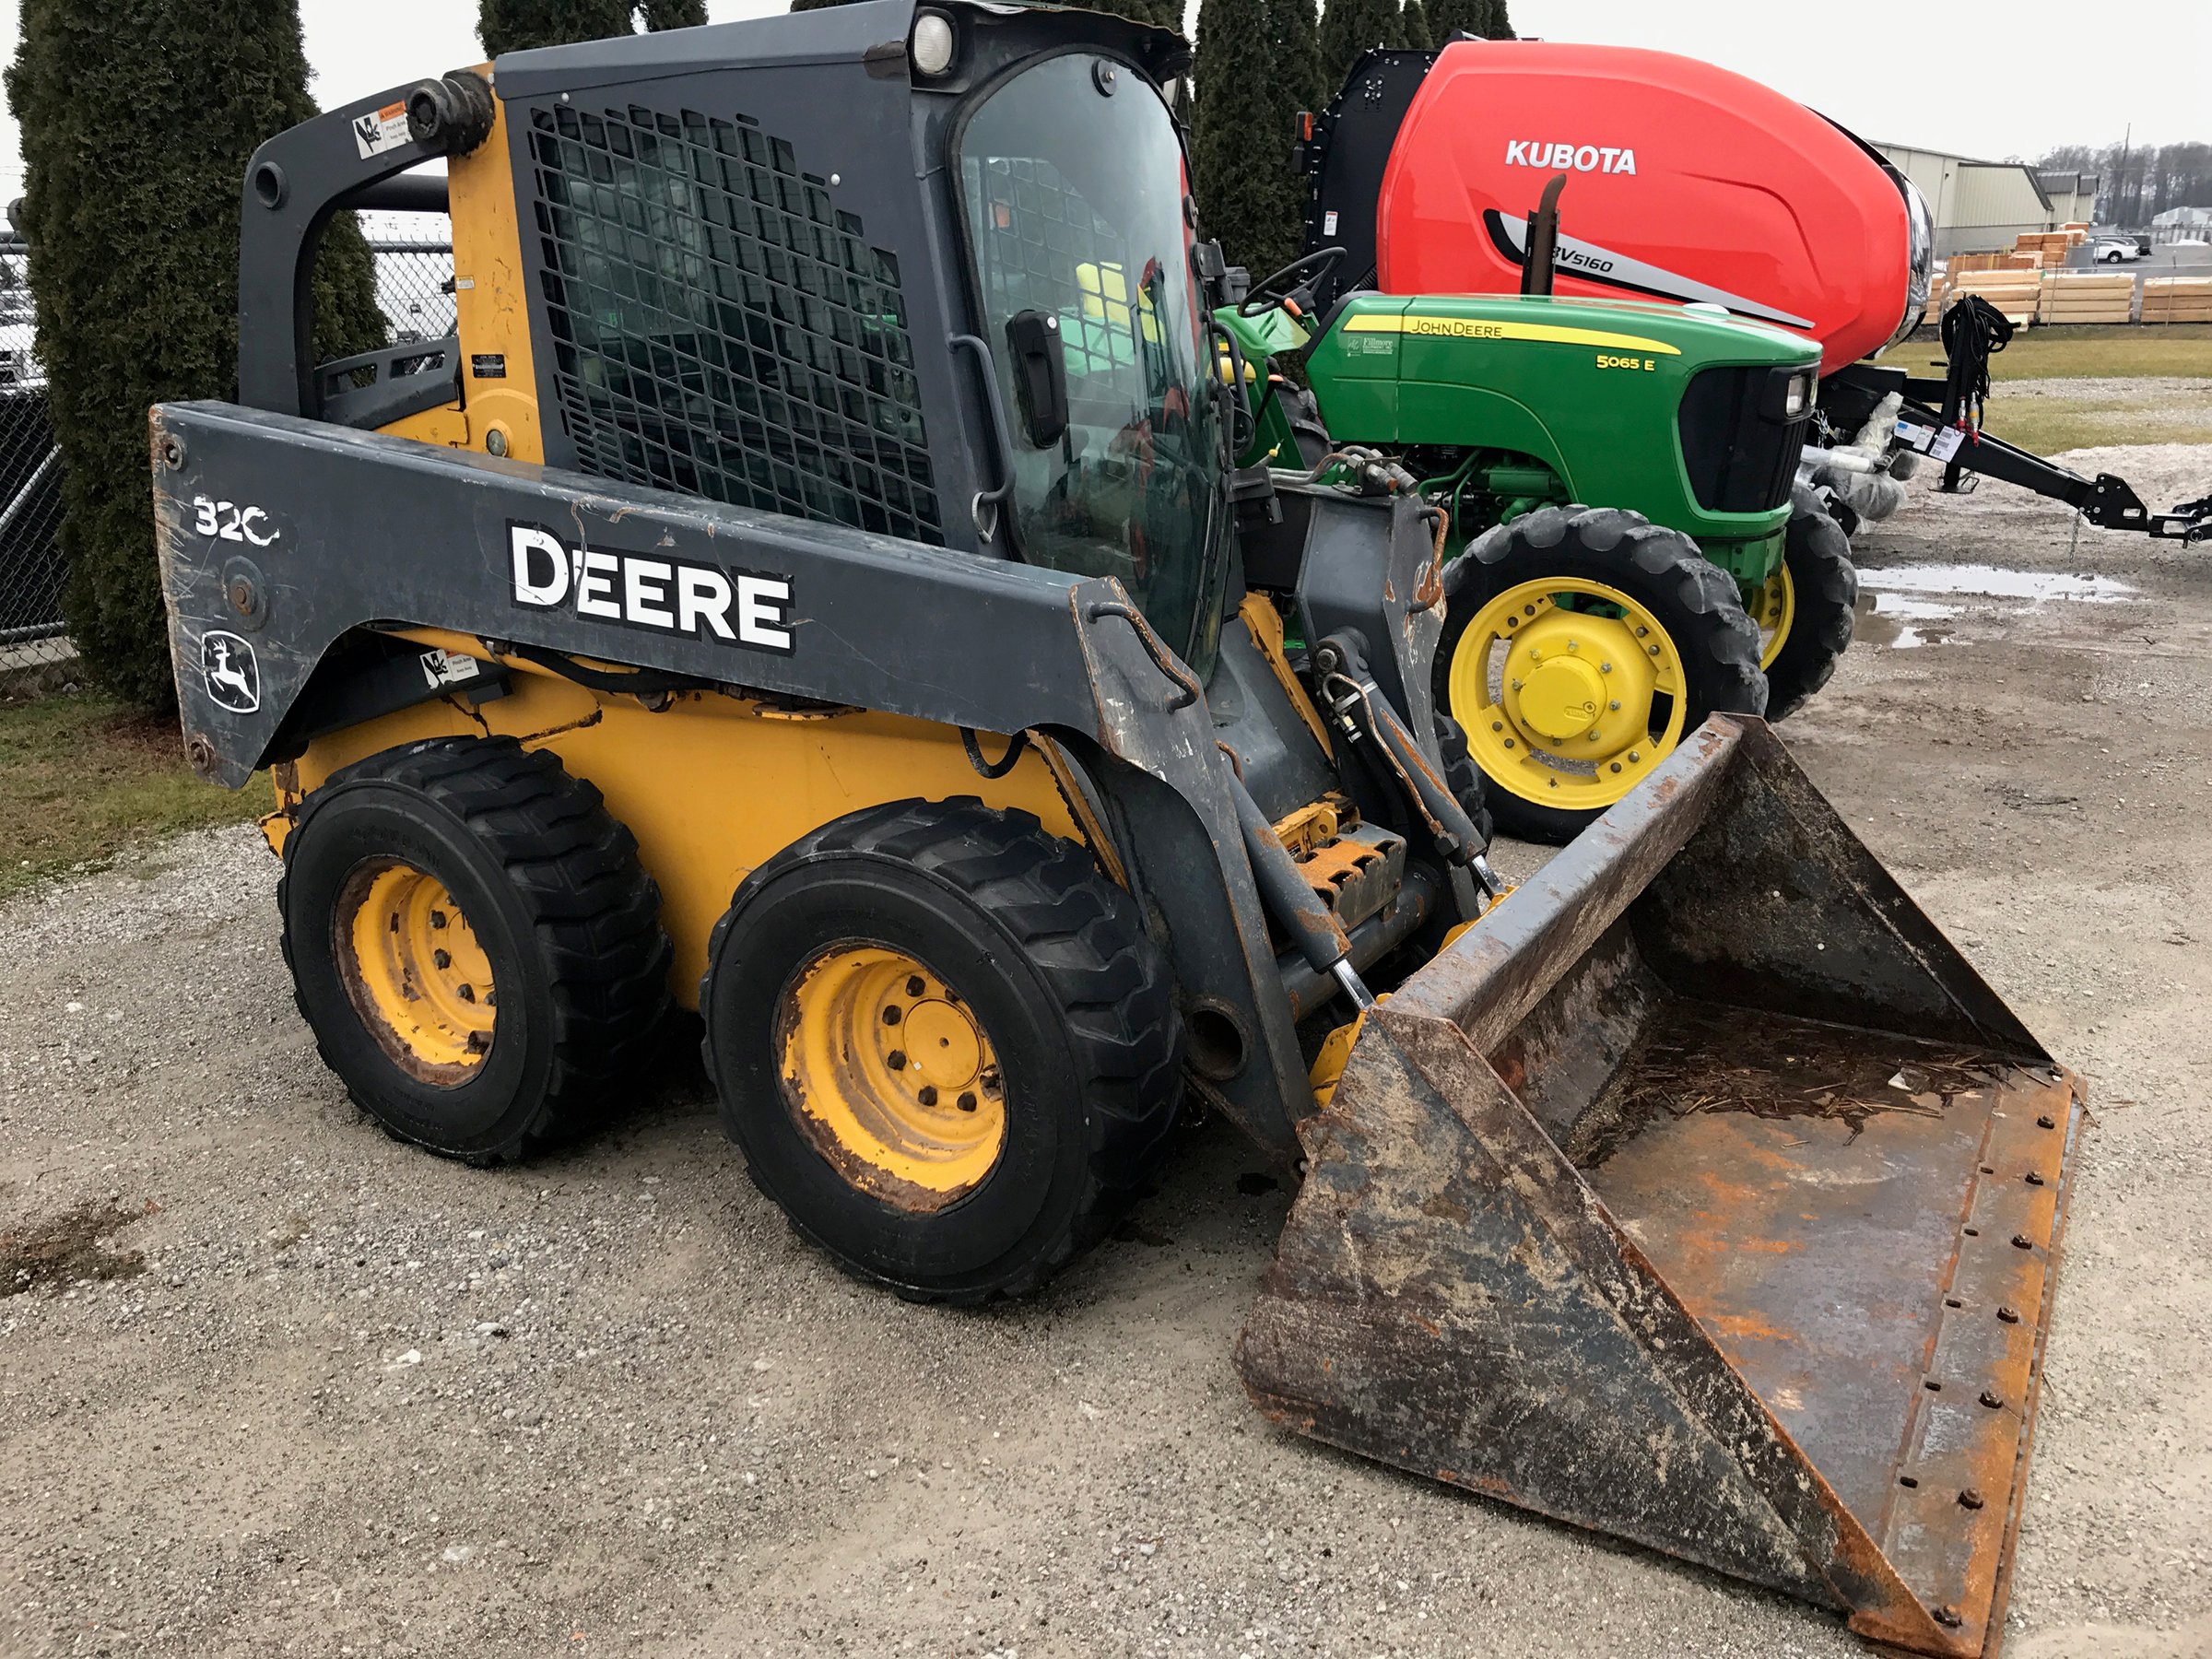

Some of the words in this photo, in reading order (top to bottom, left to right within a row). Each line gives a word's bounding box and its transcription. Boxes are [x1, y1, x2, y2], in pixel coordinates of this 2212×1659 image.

[1505, 140, 1637, 175] KUBOTA
[1412, 320, 1452, 335] JOHN
[1453, 322, 1503, 337] DEERE
[1596, 355, 1640, 370] 5065
[1643, 359, 1655, 371] E
[511, 525, 791, 650] DEERE
